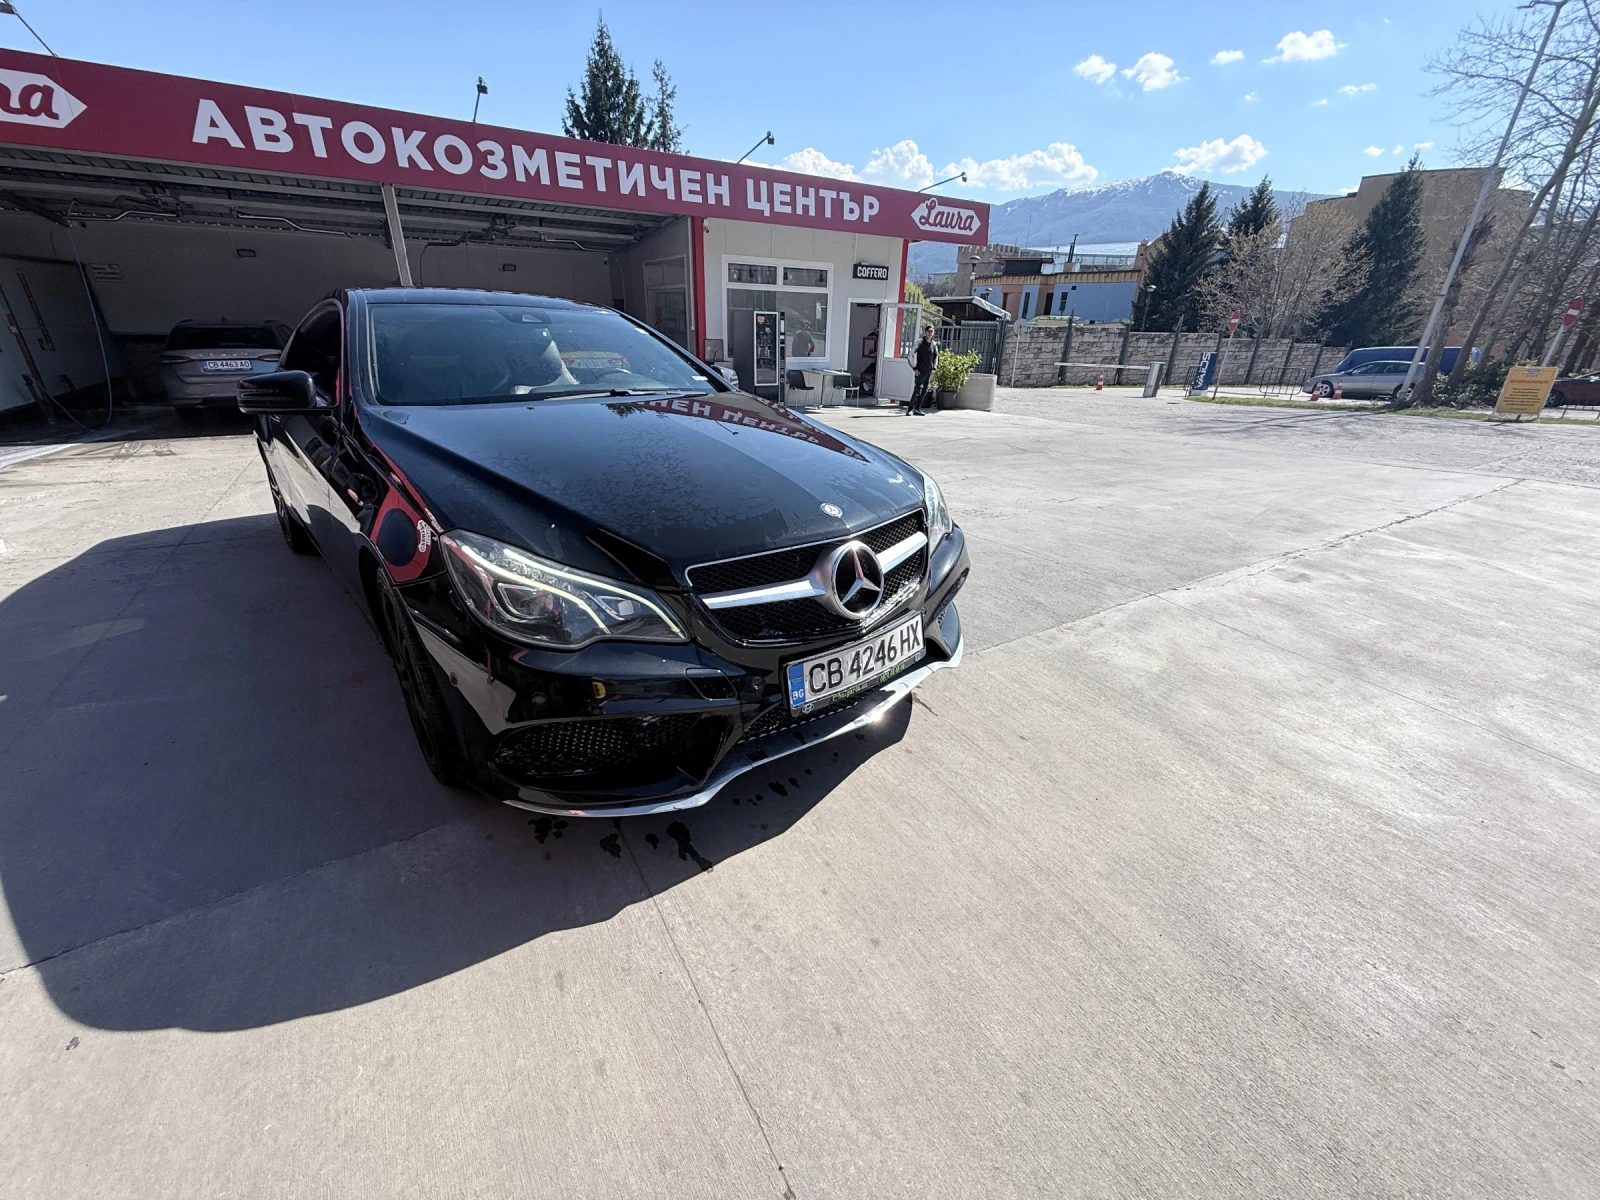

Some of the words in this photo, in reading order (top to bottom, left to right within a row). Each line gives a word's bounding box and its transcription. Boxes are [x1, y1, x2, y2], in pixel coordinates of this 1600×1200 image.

[192, 98, 731, 206] АВТОКОЗМЕТИЧЕН
[746, 178, 880, 223] ЦЕНТЪР
[919, 200, 974, 231] Laura
[857, 266, 887, 278] COFFERO
[809, 657, 844, 694] CB
[848, 634, 897, 679] 4246
[900, 620, 921, 656] HX
[792, 688, 804, 700] BG
